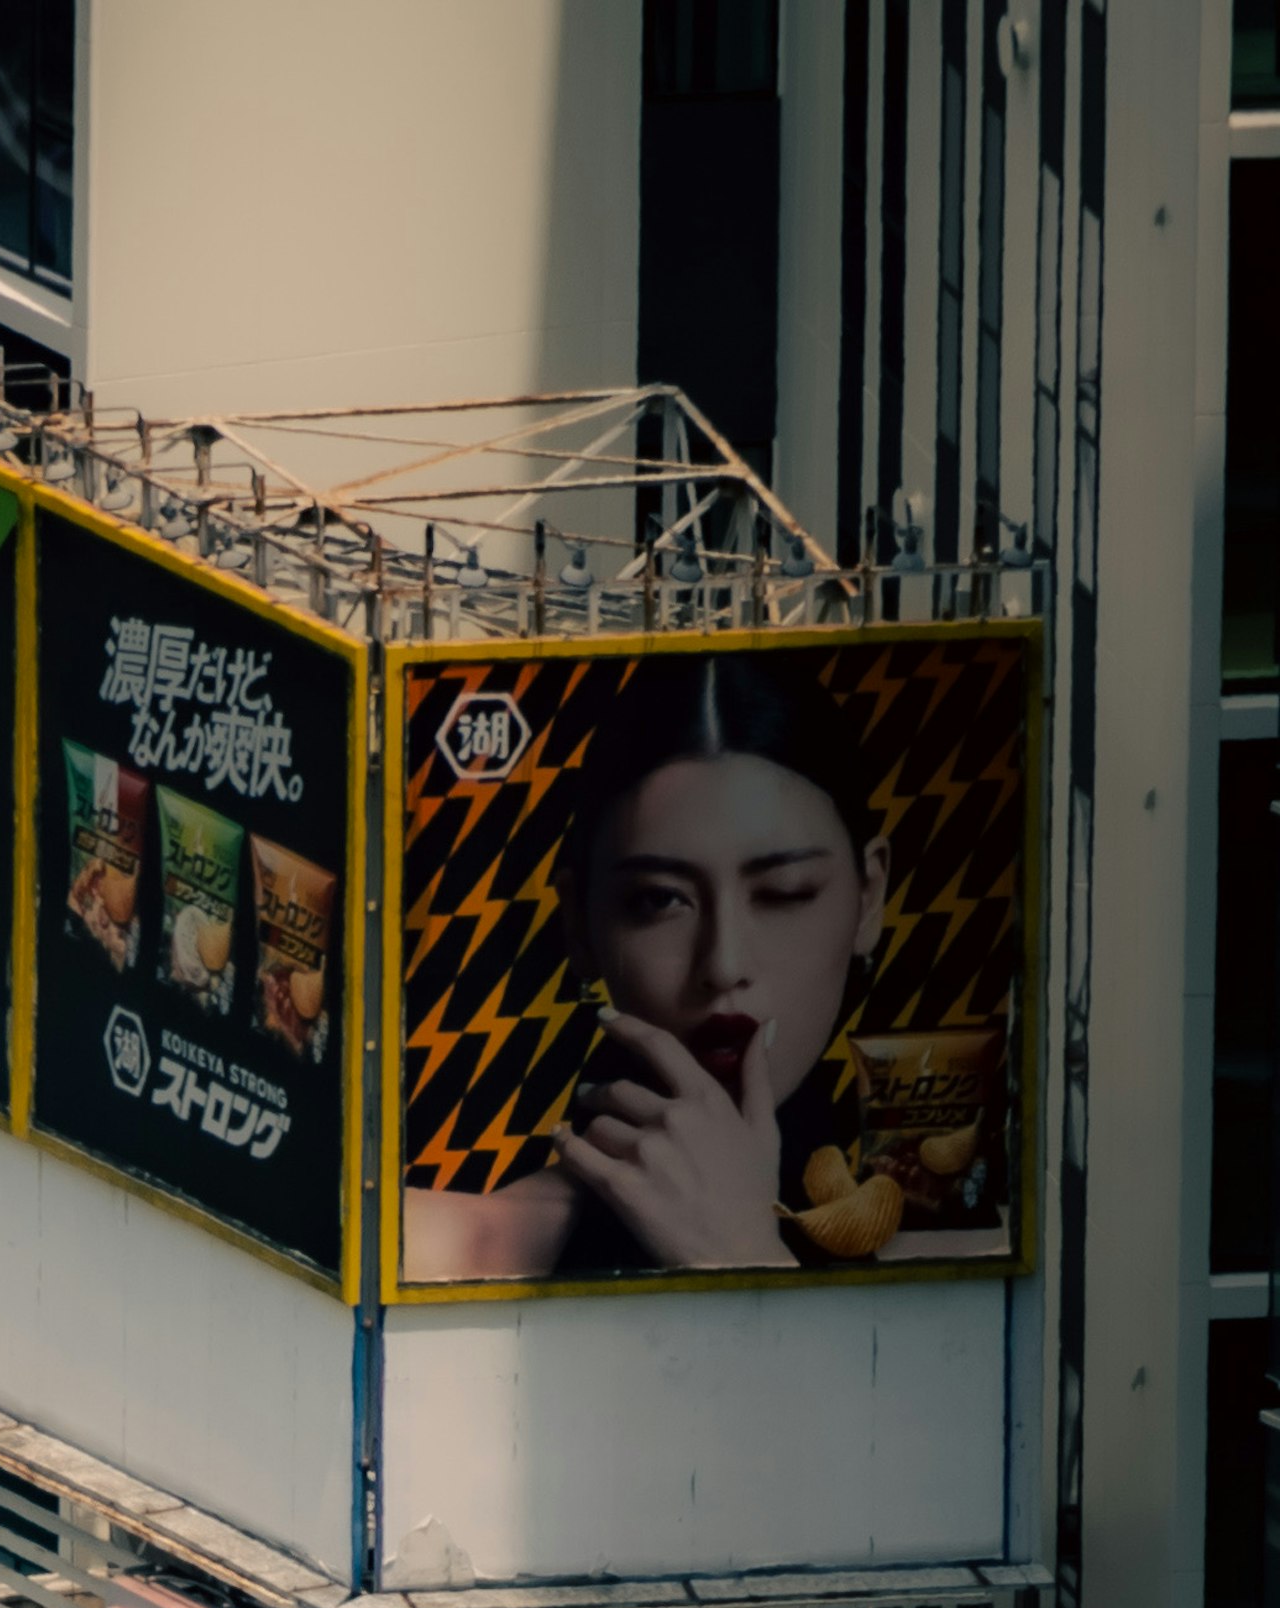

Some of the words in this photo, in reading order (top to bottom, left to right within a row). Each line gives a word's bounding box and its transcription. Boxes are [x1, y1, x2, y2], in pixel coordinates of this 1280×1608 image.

[99, 614, 274, 713] 濃厚だけど、
[127, 704, 304, 803] なんか爽快。
[151, 1055, 293, 1160] ストロング
[160, 1028, 226, 1079] KOIKEYA
[228, 1062, 289, 1110] STRONG
